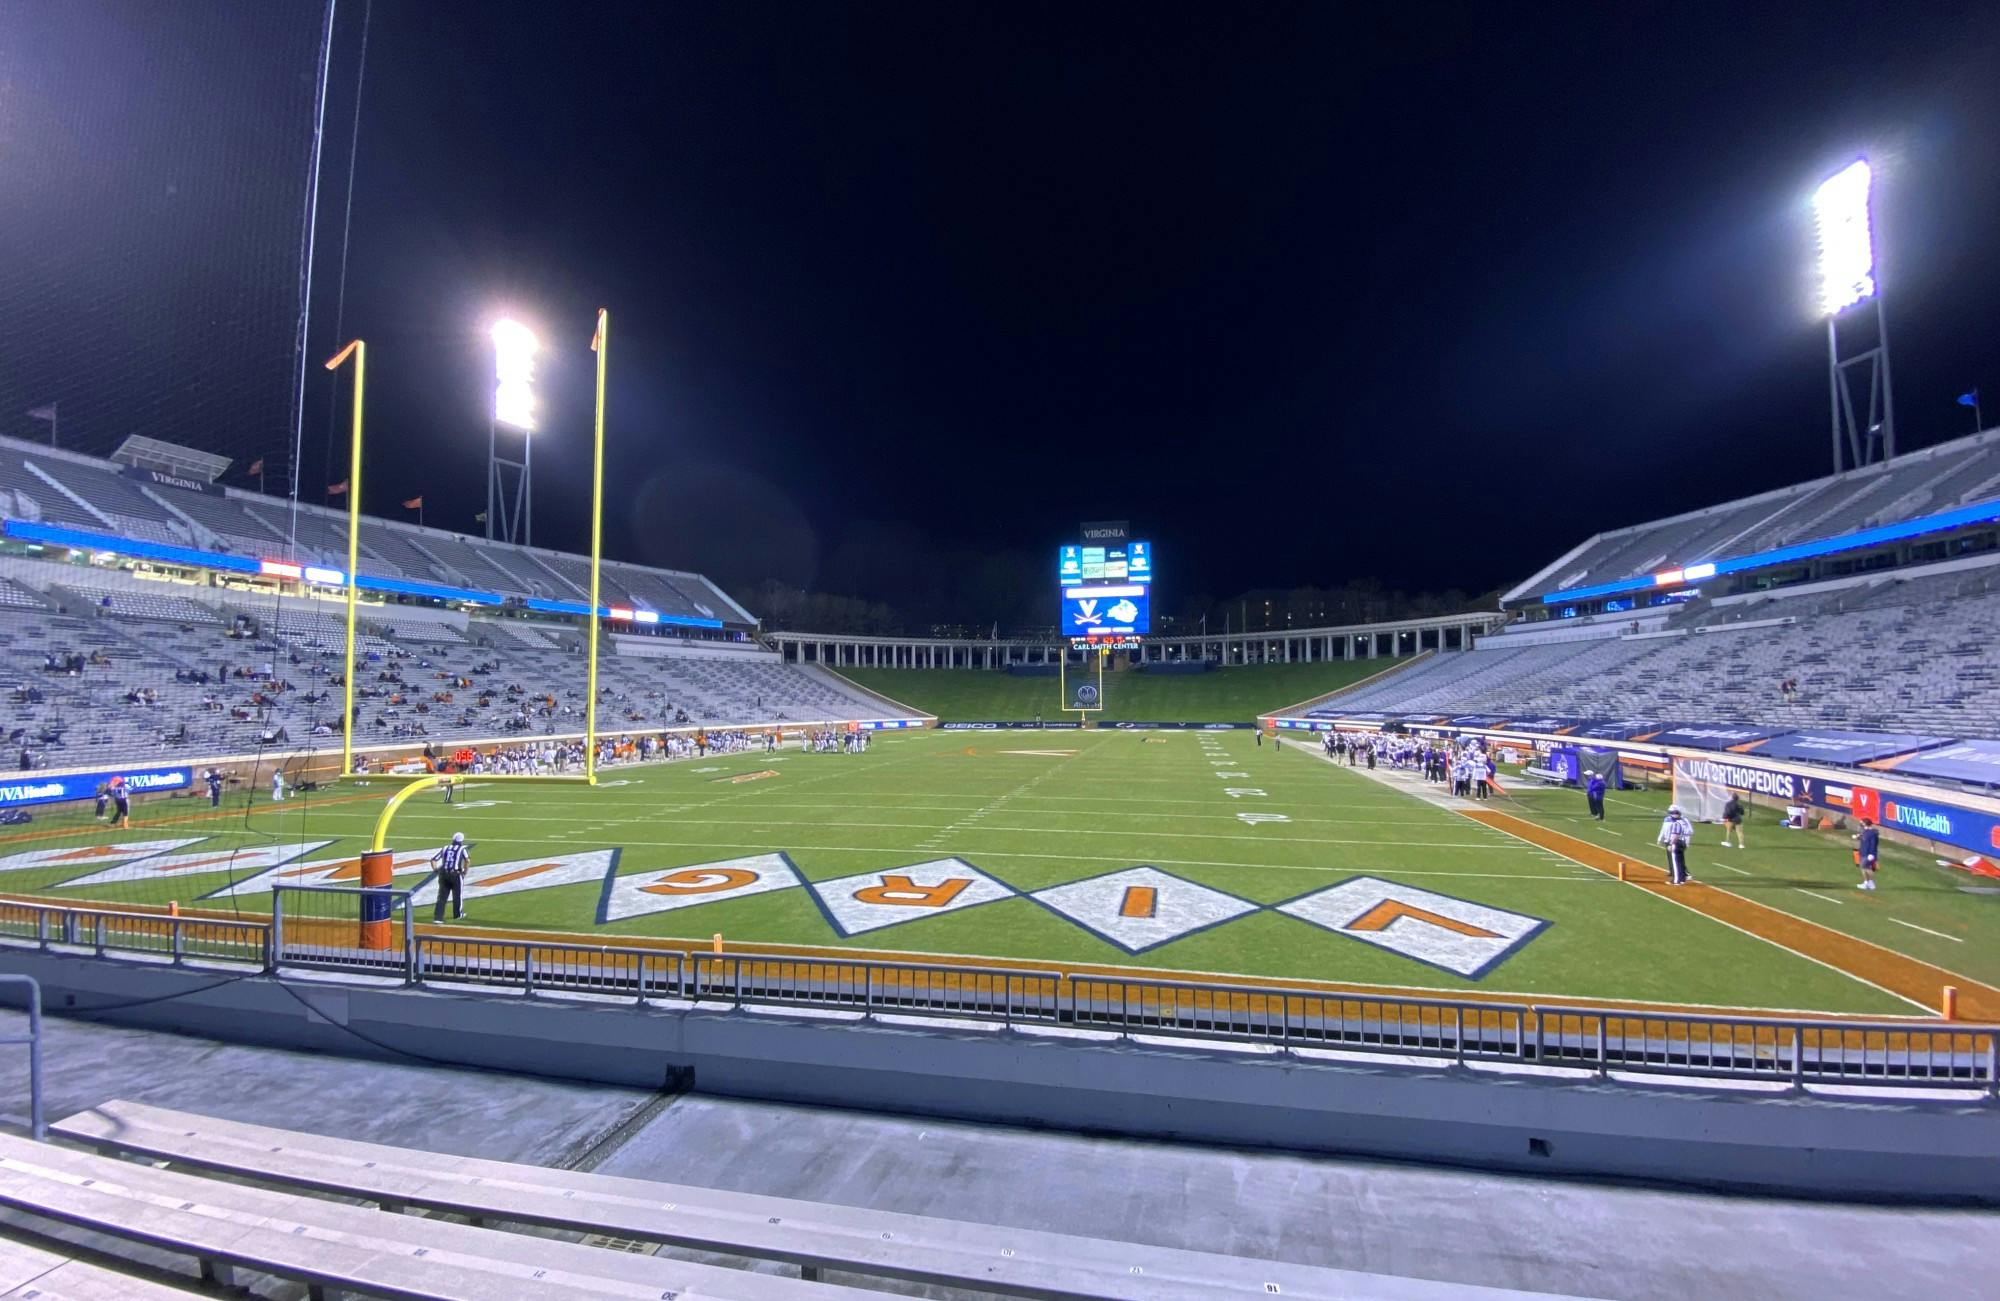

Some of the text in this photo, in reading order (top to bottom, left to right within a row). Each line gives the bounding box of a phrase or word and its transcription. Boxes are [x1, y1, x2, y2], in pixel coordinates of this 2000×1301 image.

[151, 471, 203, 491] VIRGINIA
[1084, 529, 1125, 538] VIRGINIA
[1113, 642, 1139, 650] CENTER
[1689, 760, 1794, 797] UVA ORTHOPEDICS
[446, 850, 455, 862] R
